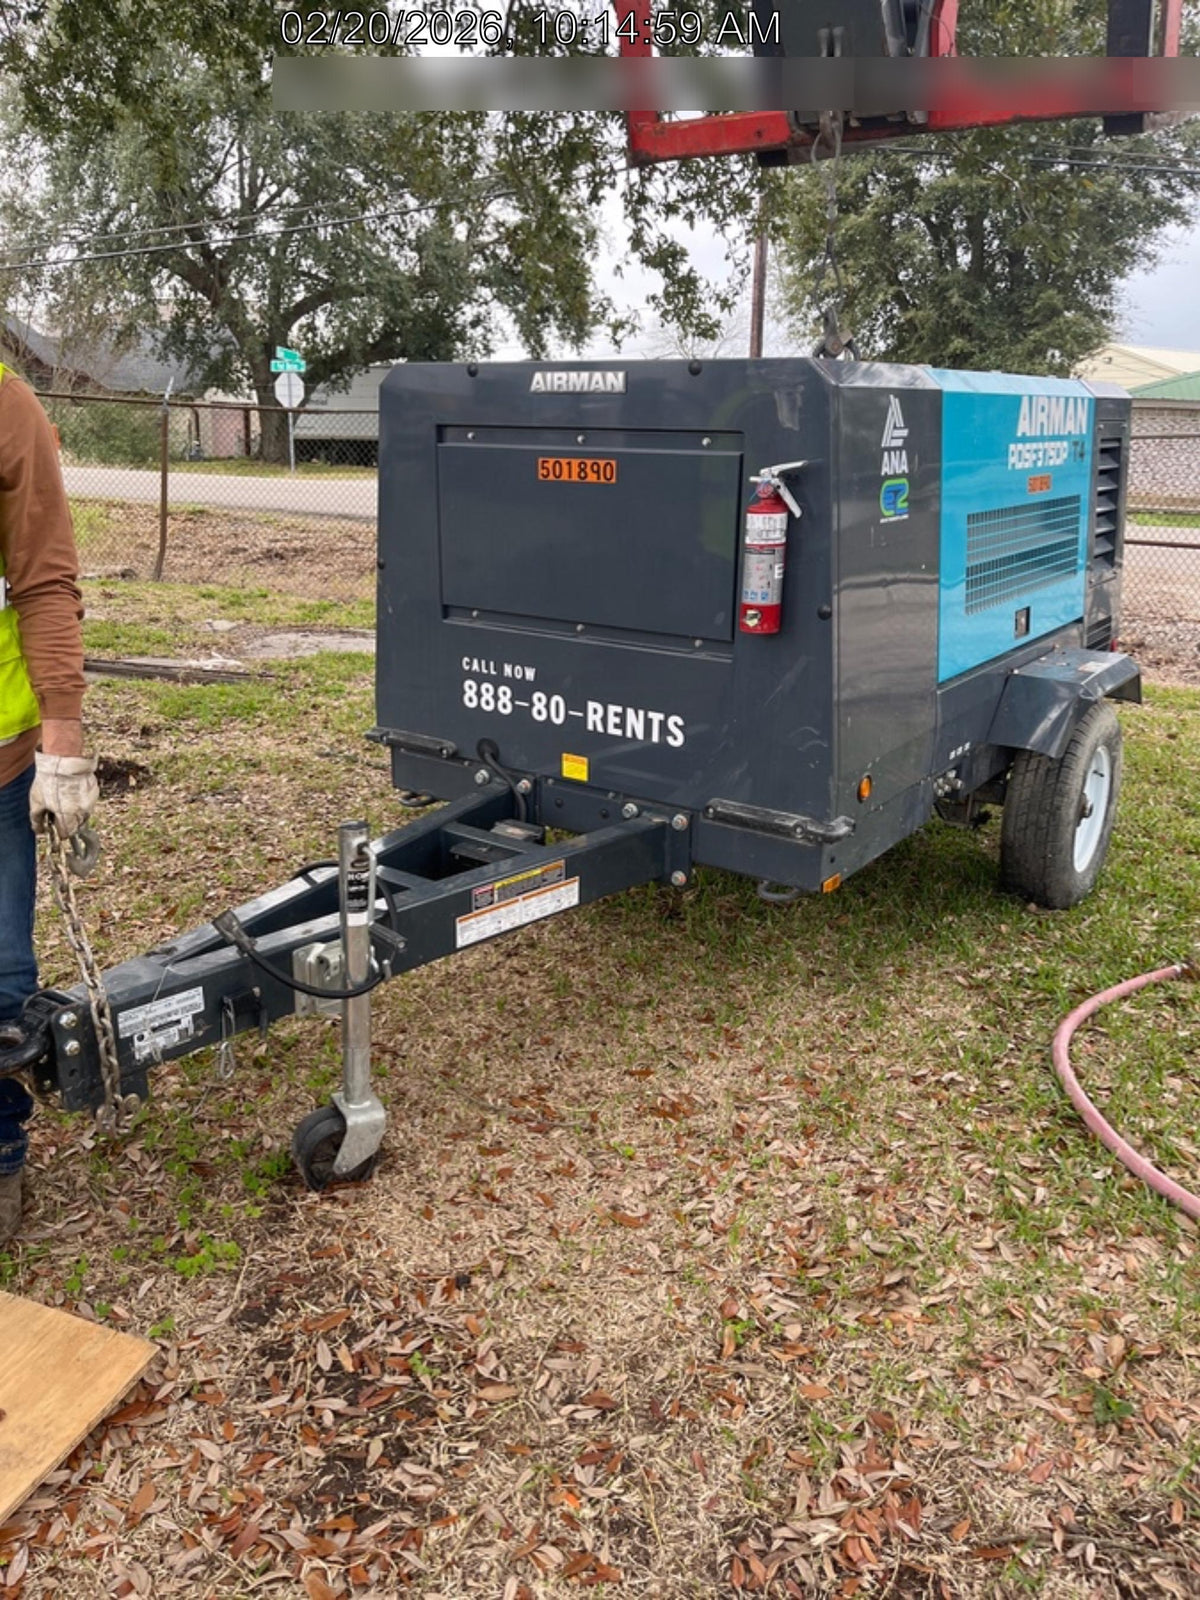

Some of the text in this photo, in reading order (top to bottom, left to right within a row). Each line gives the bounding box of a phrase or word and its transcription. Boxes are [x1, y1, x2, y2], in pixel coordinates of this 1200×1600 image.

[529, 371, 626, 393] AIRMAN
[1016, 396, 1089, 437] AIRMAN
[540, 460, 615, 482] 501890
[881, 450, 909, 476] ANA
[462, 656, 536, 682] CALL NOW
[462, 679, 685, 748] 888-80-RENTS
